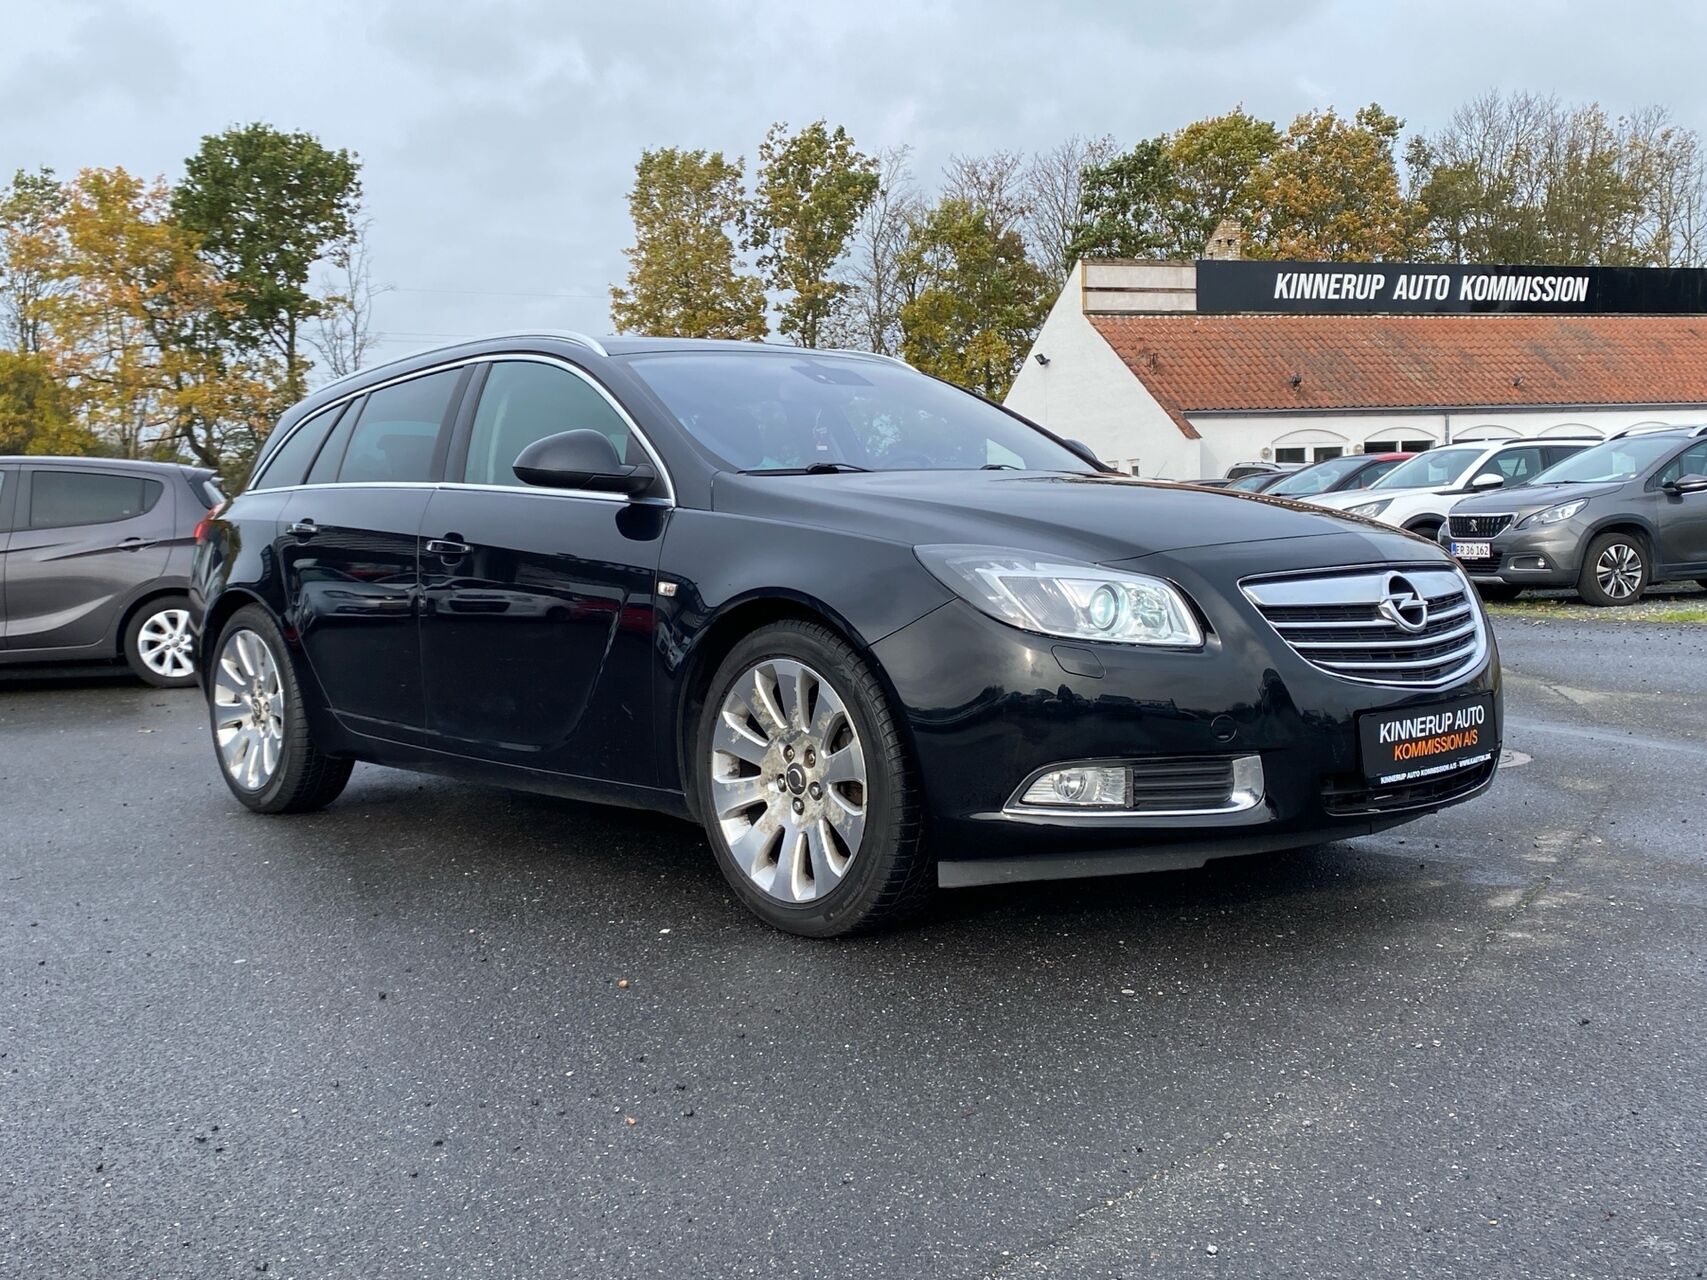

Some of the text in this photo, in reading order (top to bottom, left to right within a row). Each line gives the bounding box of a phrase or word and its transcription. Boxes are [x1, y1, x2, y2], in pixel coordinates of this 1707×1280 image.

[1274, 272, 1590, 302] KINNERUP AUTO KOMMISSION
[1466, 545, 1475, 555] 36
[1476, 545, 1489, 555] 162
[1380, 705, 1485, 743] KINNERUP AUTO
[1394, 729, 1479, 761] KOMMISSION A/S
[1380, 773, 1407, 784] KINNERUP
[1407, 770, 1421, 779] AUTO
